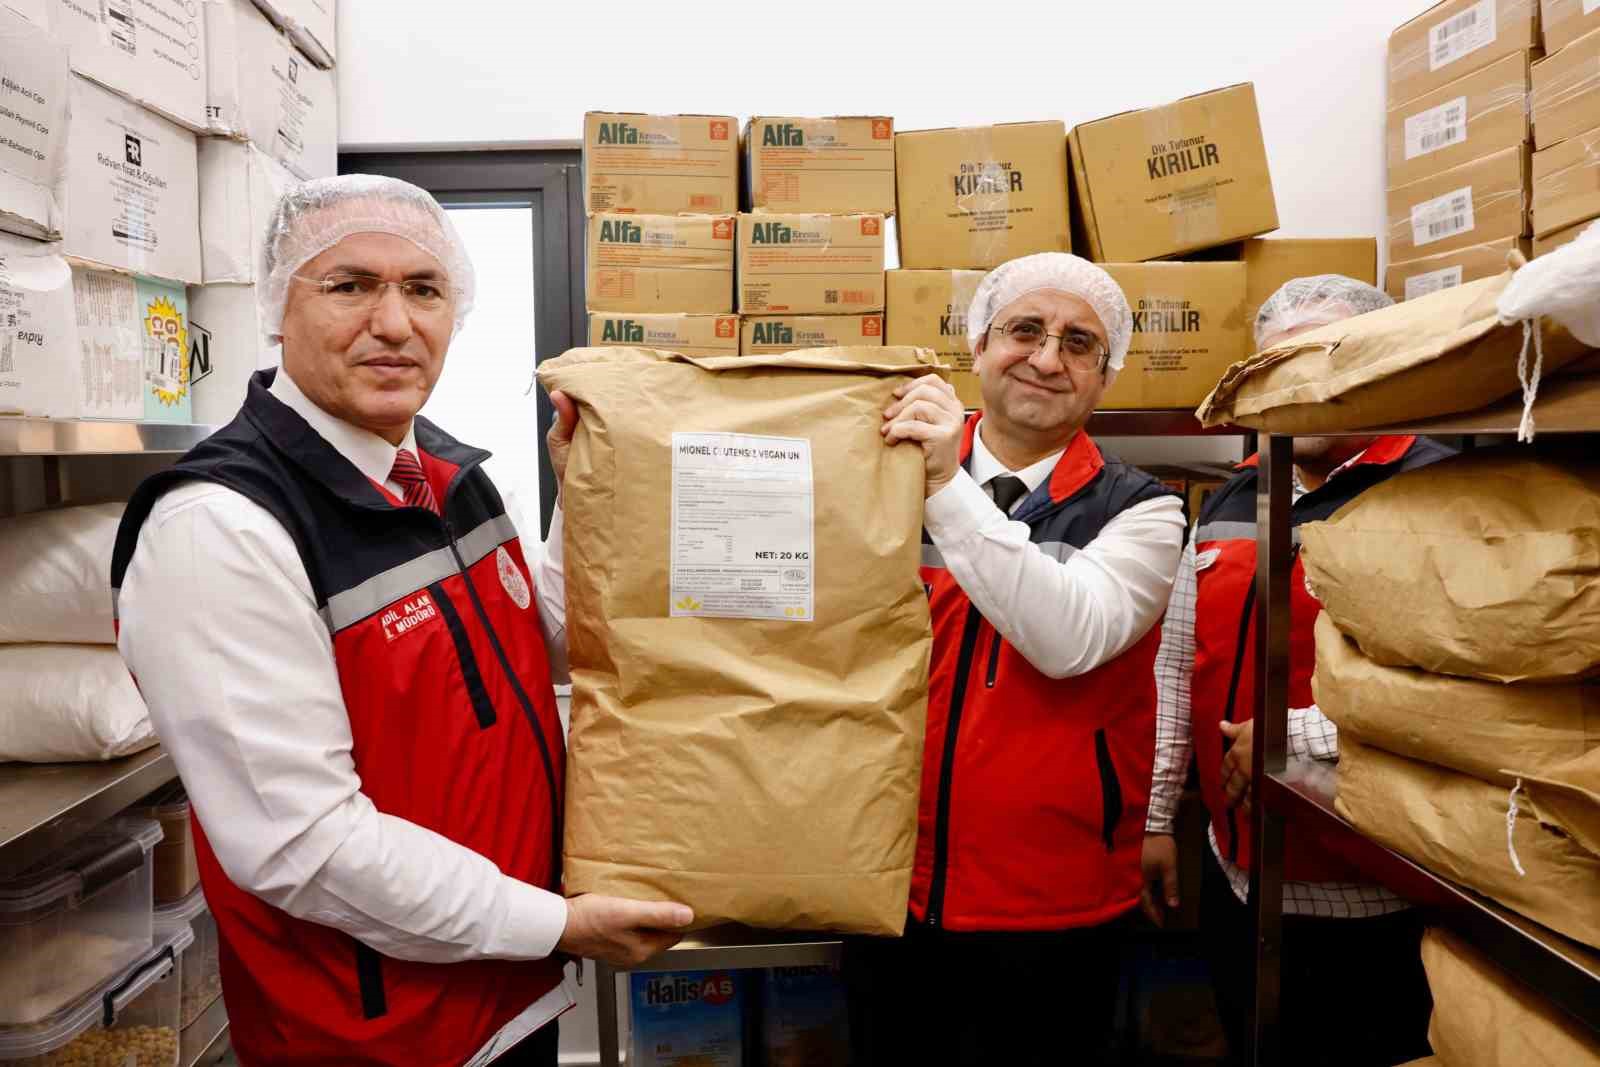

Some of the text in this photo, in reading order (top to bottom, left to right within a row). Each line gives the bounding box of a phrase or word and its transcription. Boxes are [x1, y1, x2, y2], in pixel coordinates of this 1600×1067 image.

[598, 122, 638, 144] Alfa
[763, 123, 803, 146] Alfa
[1147, 143, 1219, 180] KIRILIR
[600, 220, 641, 243] Alfa
[752, 222, 791, 244] Alfa
[602, 319, 643, 342] Alfa
[753, 322, 793, 344] Alfa
[1132, 311, 1200, 333] KIRILIR
[755, 551, 809, 560] NET: 20 KG
[646, 977, 698, 1005] Halis
